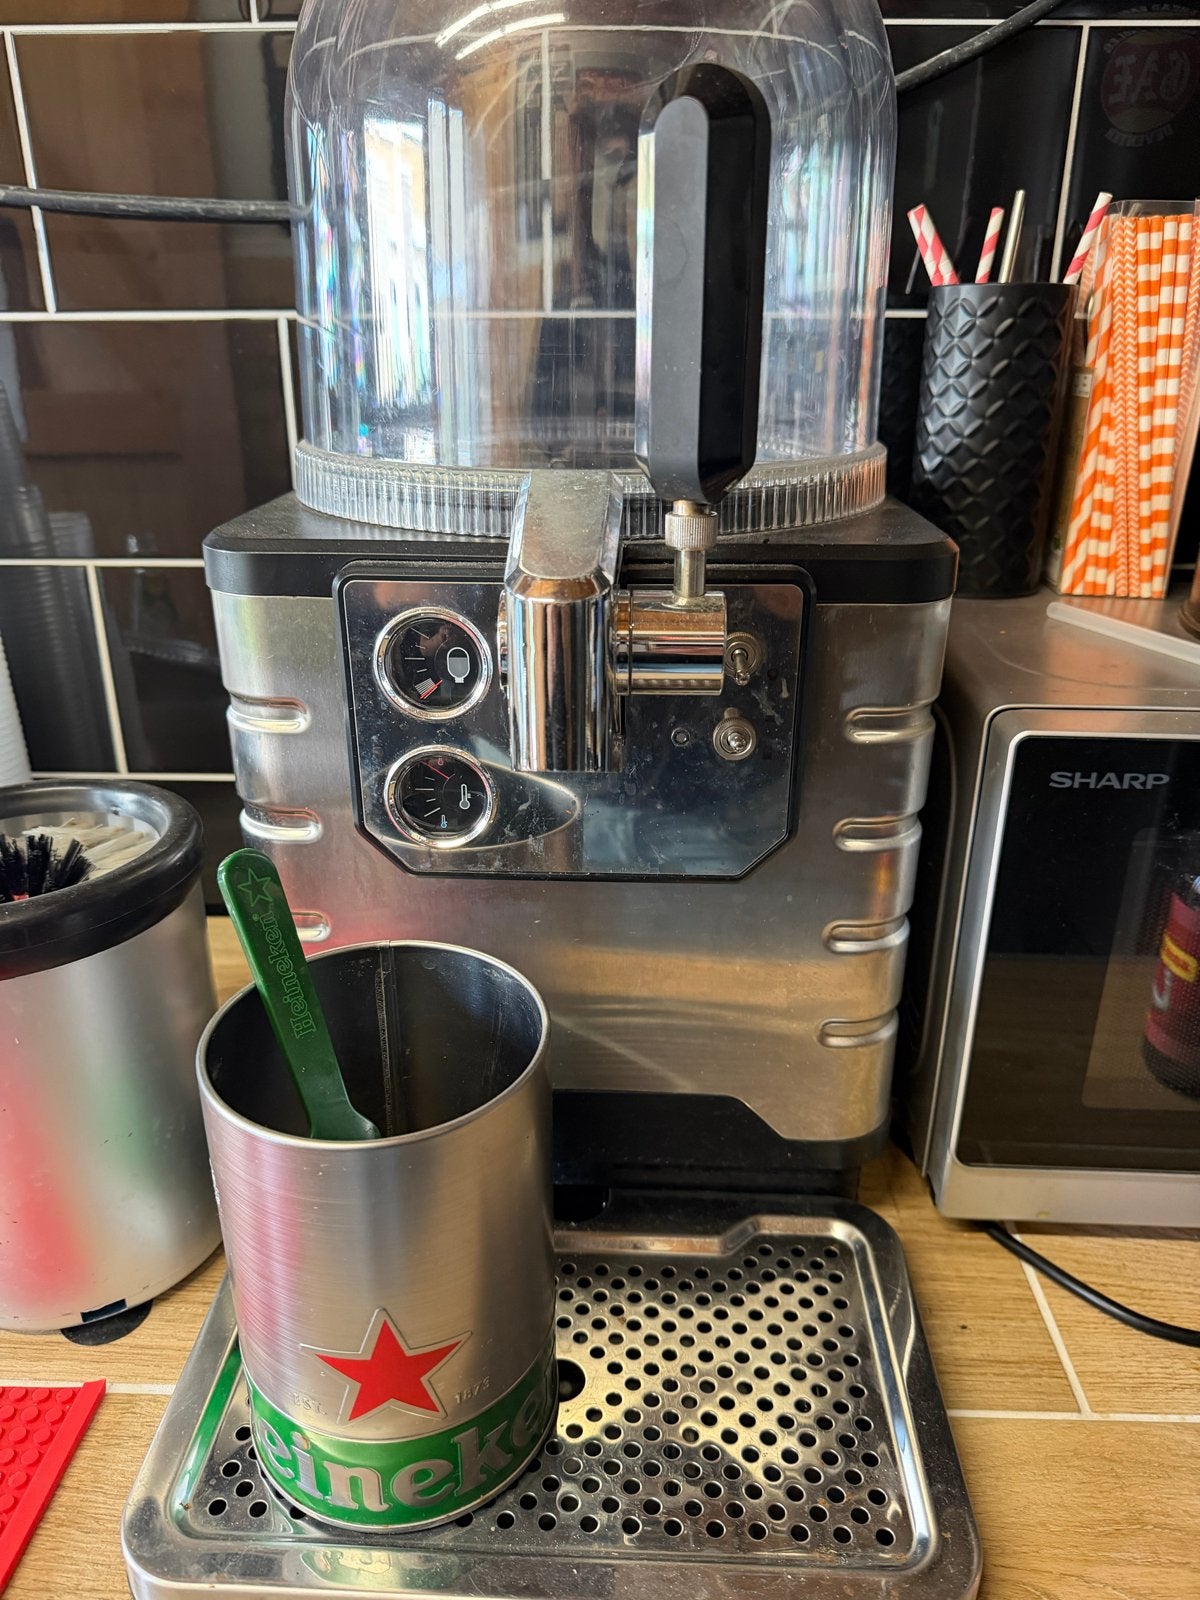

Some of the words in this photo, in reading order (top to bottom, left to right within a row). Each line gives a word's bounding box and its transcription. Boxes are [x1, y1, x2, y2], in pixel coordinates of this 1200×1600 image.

[1049, 771, 1170, 789] SHARP
[259, 911, 317, 1038] Heineken
[254, 1378, 550, 1512] eineke
